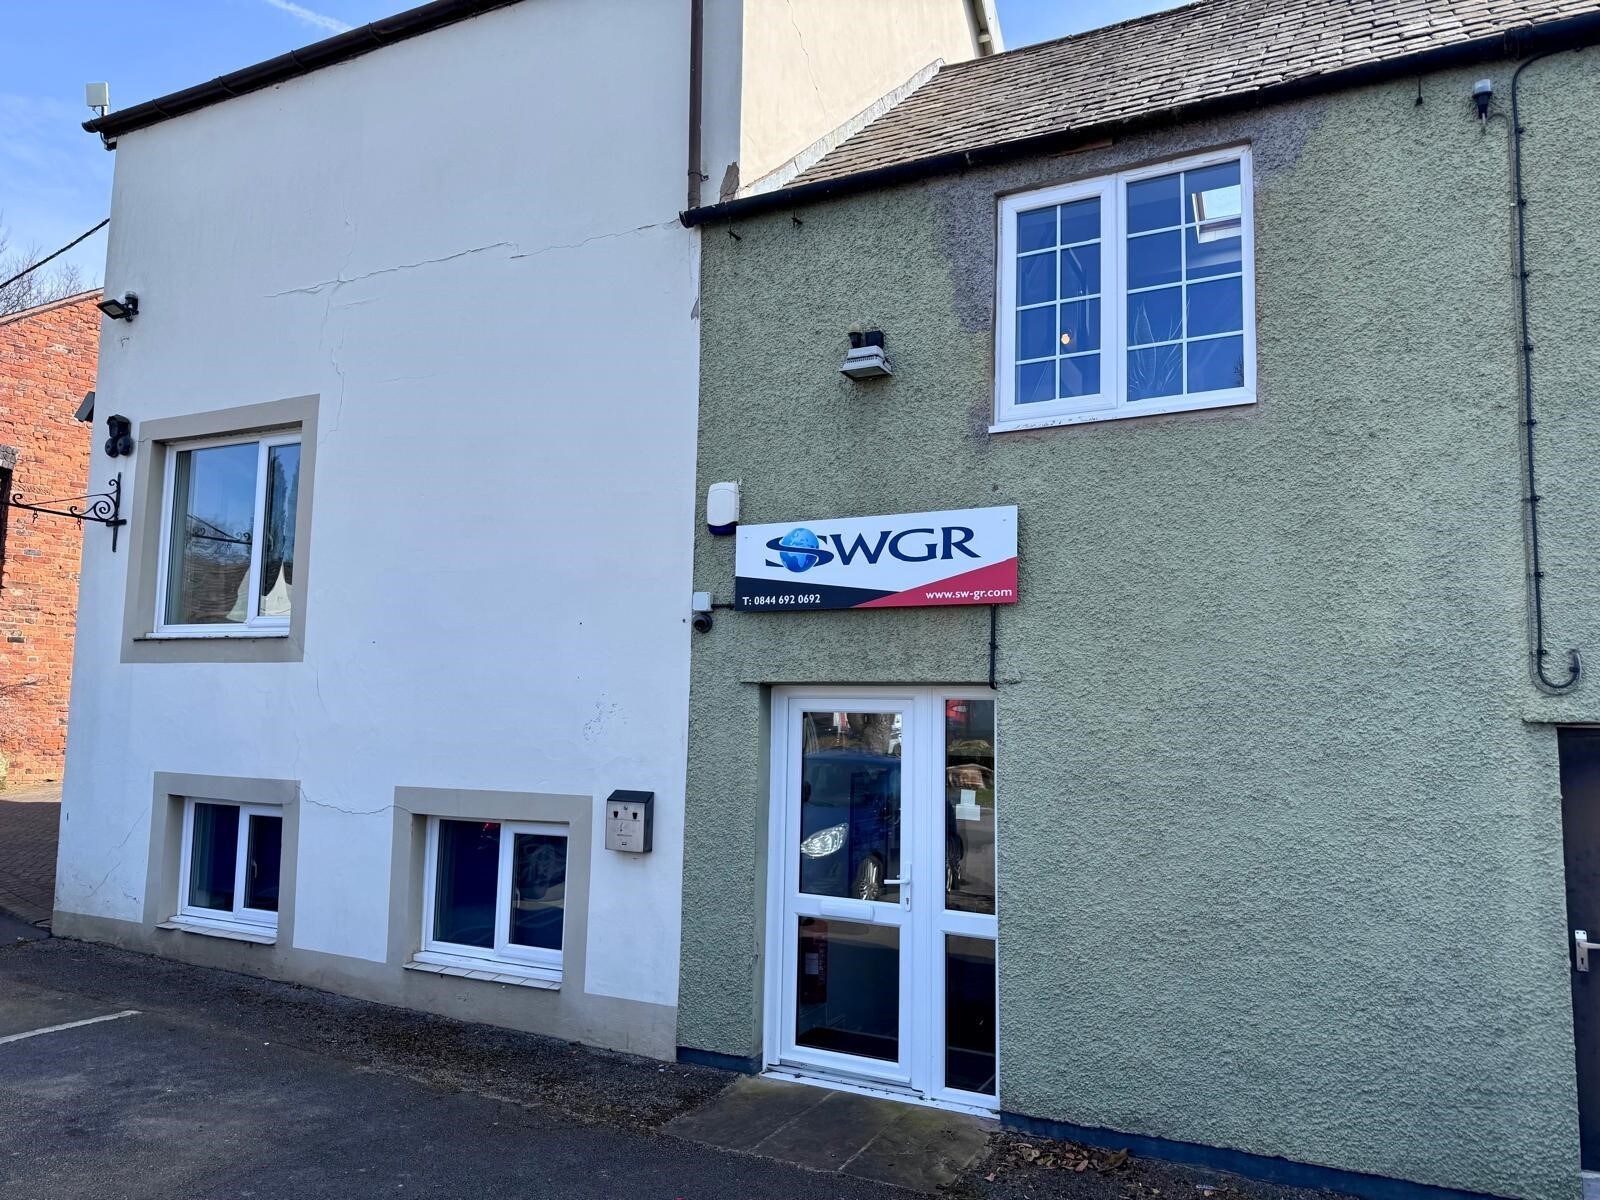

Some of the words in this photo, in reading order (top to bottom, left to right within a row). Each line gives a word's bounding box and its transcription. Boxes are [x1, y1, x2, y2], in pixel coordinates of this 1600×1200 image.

[765, 526, 981, 569] SWGR
[742, 596, 752, 606] T:
[754, 595, 776, 605] 0844
[778, 595, 795, 604] 692
[798, 594, 821, 604] 0692
[925, 589, 1012, 600] www.sw-gr.com
